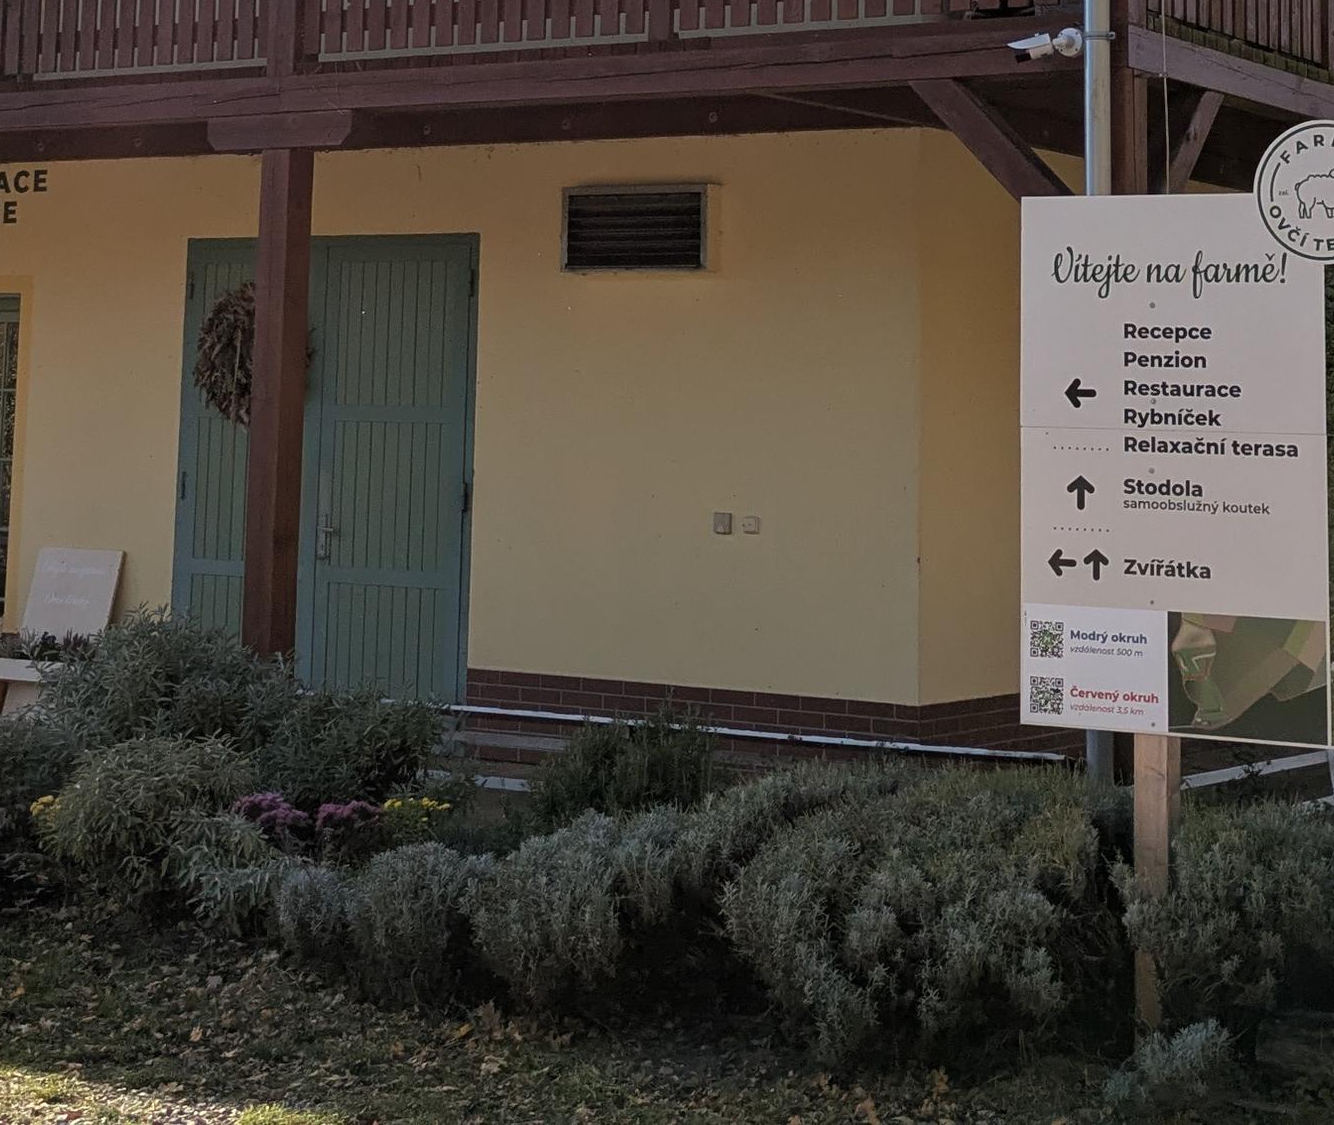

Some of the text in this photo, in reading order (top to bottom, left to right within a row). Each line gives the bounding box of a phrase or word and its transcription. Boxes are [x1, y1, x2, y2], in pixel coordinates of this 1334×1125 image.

[1269, 205, 1309, 247] OVČÍ
[1051, 246, 1287, 299] Vítejte na farmě!
[1123, 323, 1212, 343] Recepce
[1123, 350, 1207, 369] Penzion
[1123, 380, 1242, 398] Restaurace
[1123, 408, 1222, 428] Rybníček
[1123, 436, 1299, 458] Relaxační terasa
[1123, 478, 1203, 497] Stodola
[1123, 499, 1270, 515] samoobslužný koutek
[1123, 558, 1212, 579] Zvířátka
[1070, 629, 1148, 644] Modrý okruh
[1070, 645, 1115, 656] vzdálenost
[1117, 648, 1132, 657] 500
[1070, 685, 1159, 704] Červený okruh
[1070, 703, 1144, 716] vzdálenost 3,5 km
